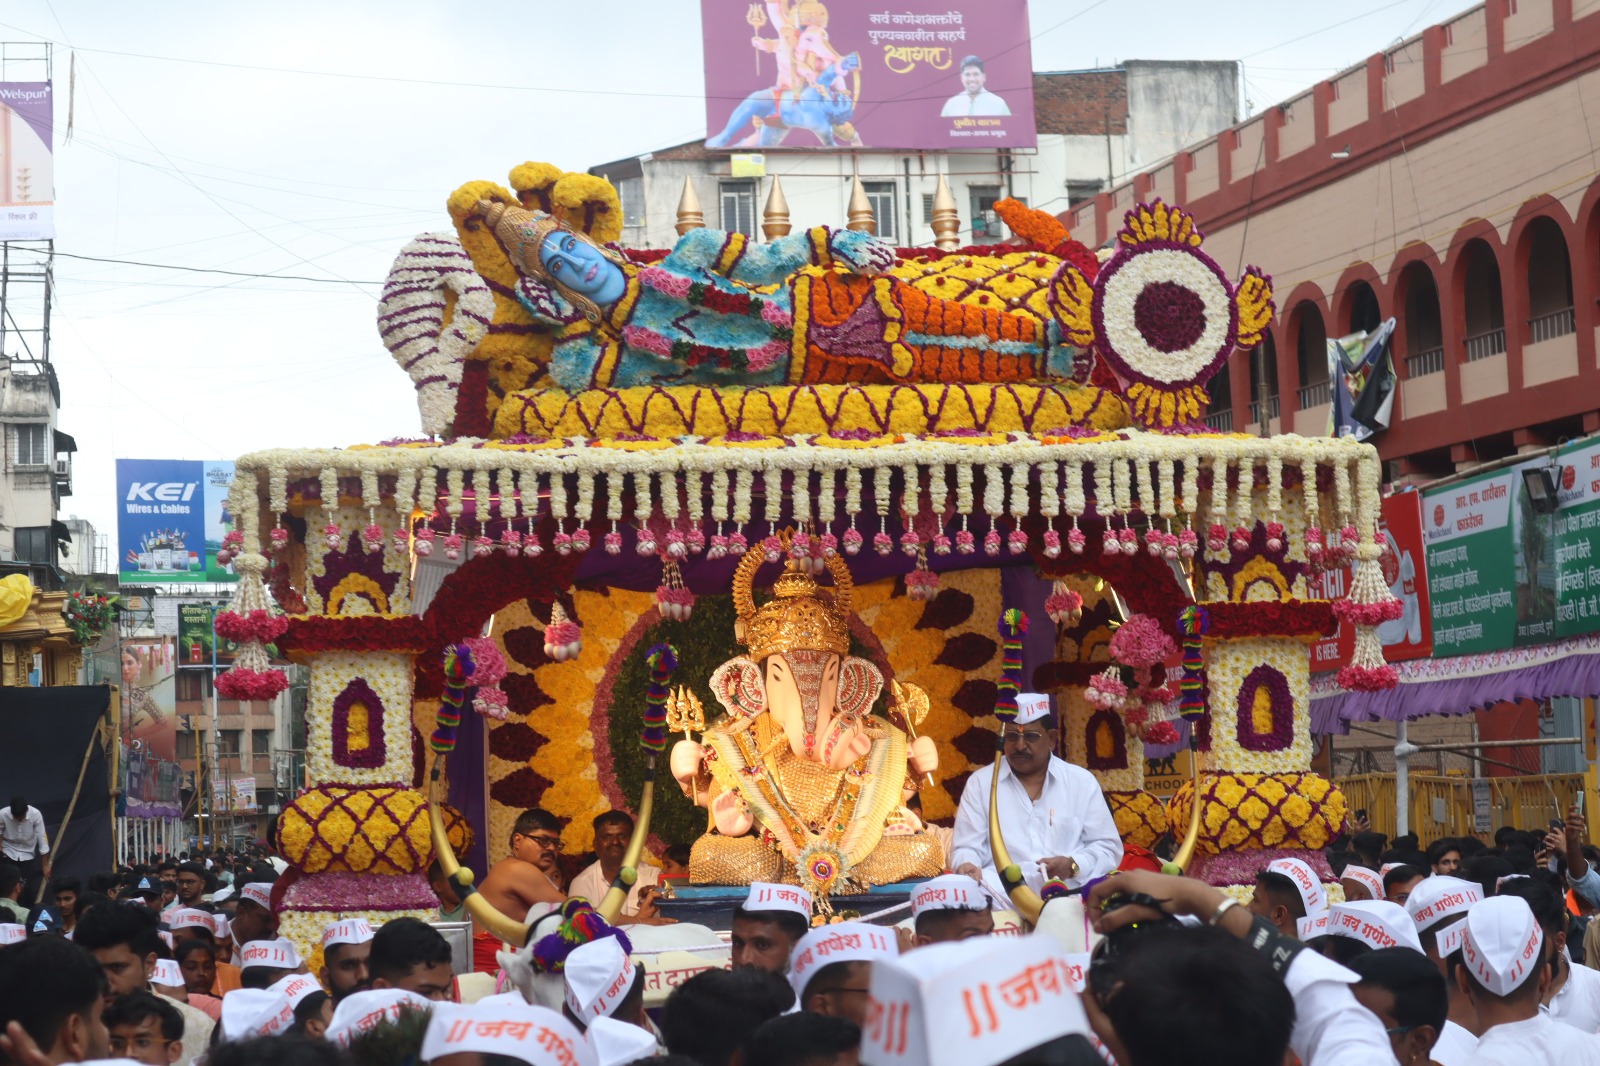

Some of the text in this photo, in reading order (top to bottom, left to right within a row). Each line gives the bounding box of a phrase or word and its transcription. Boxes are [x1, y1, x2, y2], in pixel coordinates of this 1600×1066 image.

[868, 11, 889, 24] सर्व
[937, 27, 966, 42] सहर्ष
[0, 89, 47, 101] Welspun
[126, 482, 197, 501] KEI
[127, 504, 190, 514] Wires & Cables
[184, 615, 207, 623] मस्तानी
[1144, 779, 1185, 790] CHOO
[776, 890, 799, 904] जय
[917, 887, 947, 906] गणेश
[1414, 906, 1434, 922] जय
[1434, 893, 1464, 911] गणेश
[1342, 914, 1361, 932] जय
[815, 932, 863, 956] गणेश
[1523, 930, 1539, 960] जय
[606, 972, 627, 998] जय
[999, 956, 1063, 1009] जय
[475, 1020, 533, 1041] जय
